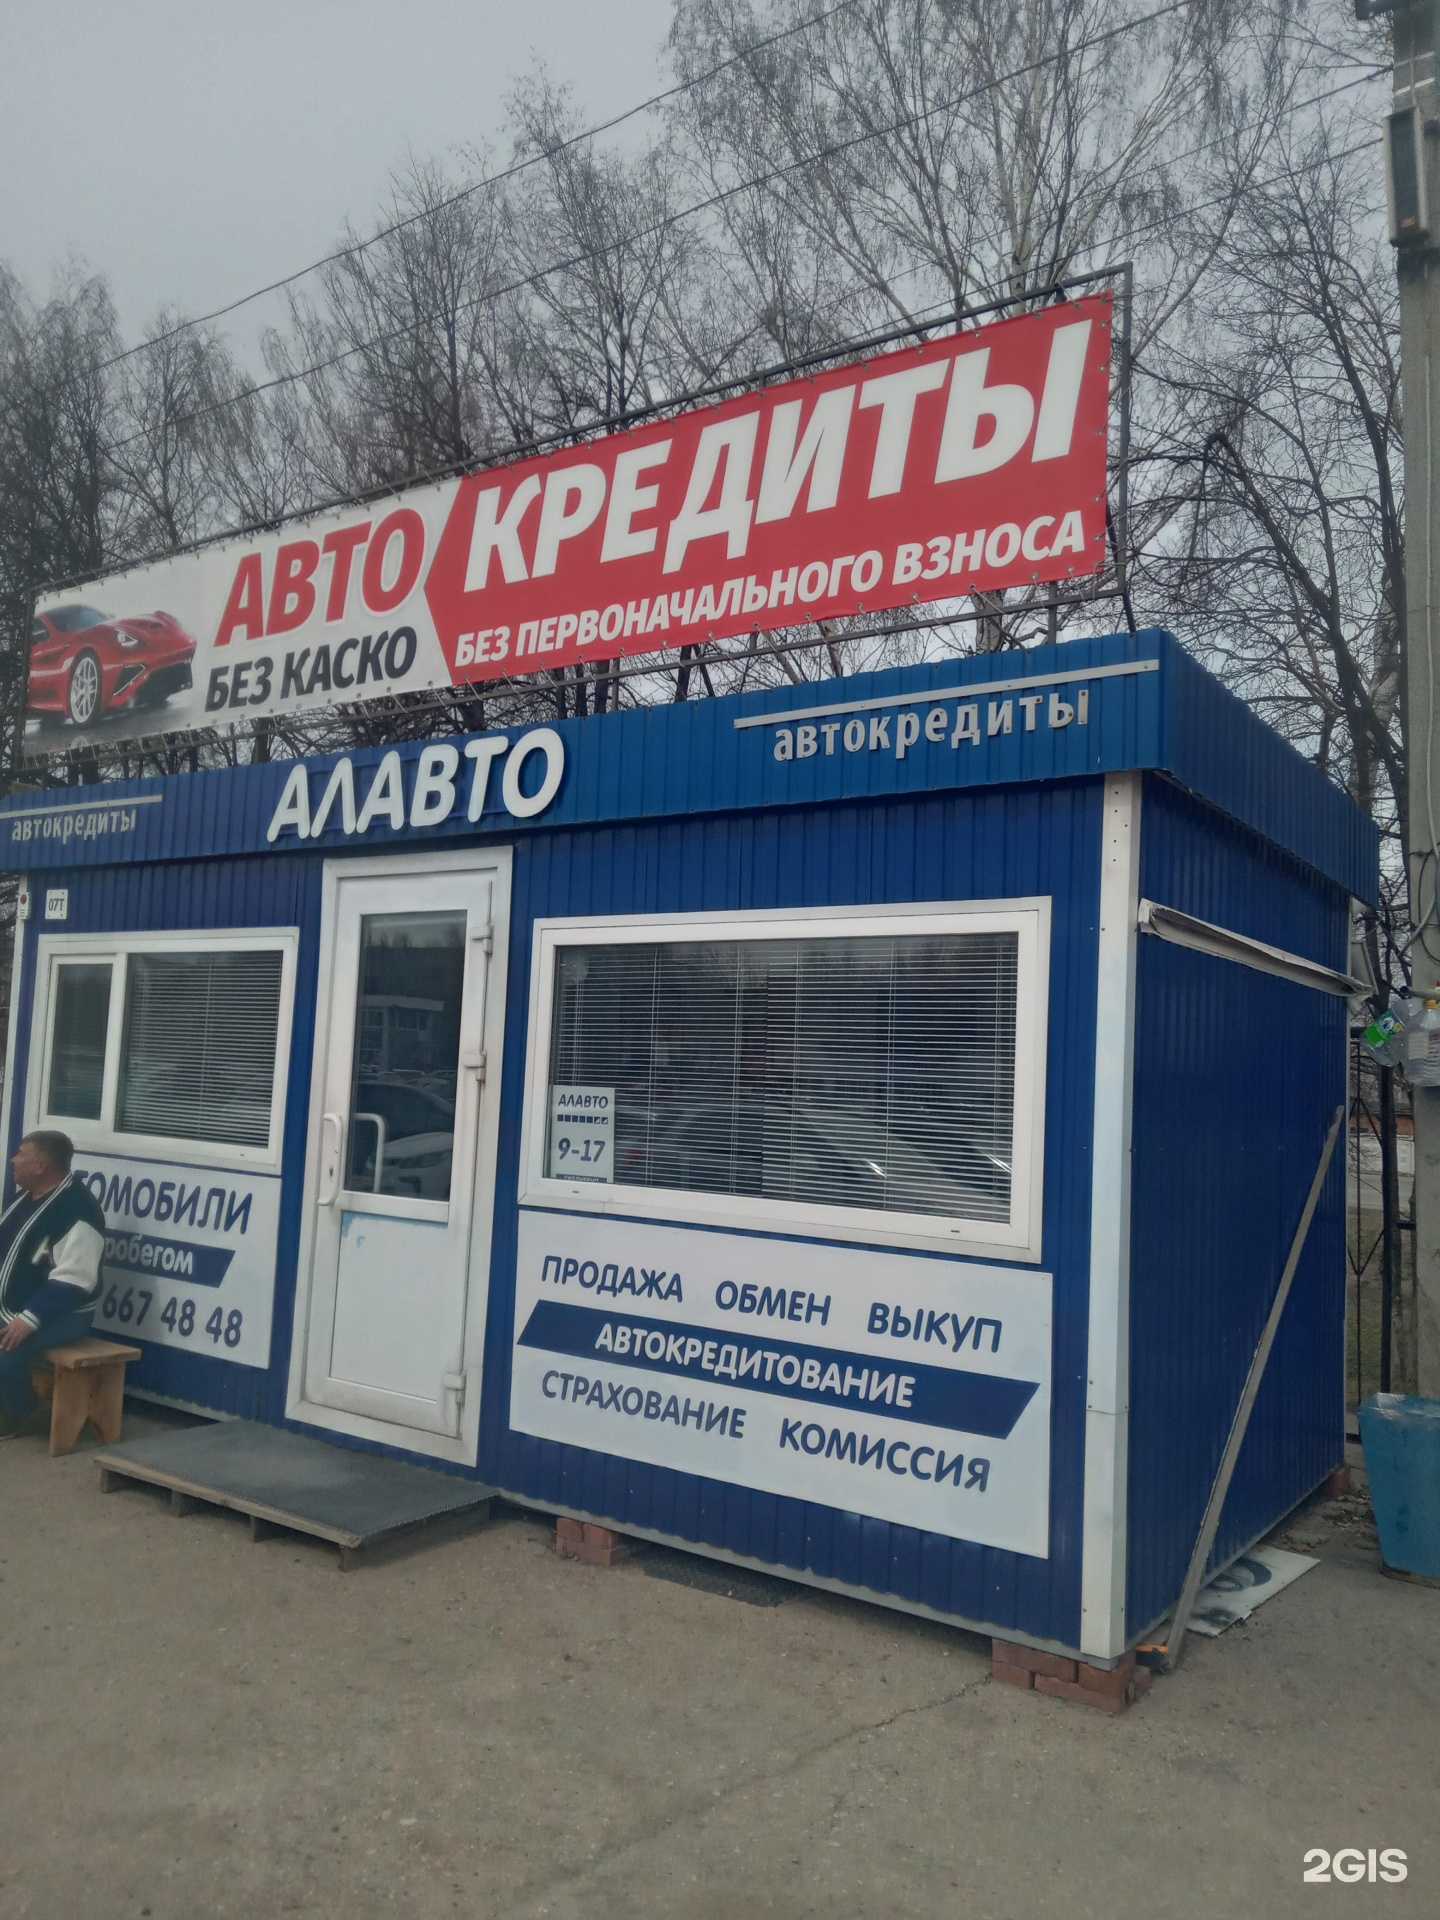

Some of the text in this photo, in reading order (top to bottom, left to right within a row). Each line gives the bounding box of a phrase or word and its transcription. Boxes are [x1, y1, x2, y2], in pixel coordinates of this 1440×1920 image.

[213, 319, 1092, 647] АВТО КРЕДИТЫ
[455, 510, 1086, 668] БЕЗ ПЕРВОНАЧАЛЬНОГО ВЗНОСА
[204, 626, 418, 713] БЕЗ КАСКО
[773, 689, 1088, 763] автокредиты
[267, 727, 565, 843] АЛАВТО
[11, 809, 137, 845] автокредиты
[558, 1093, 608, 1109] АЛАВТО
[558, 1137, 606, 1162] 9-17
[73, 1170, 253, 1235] ОМОБИЛИ
[104, 1233, 193, 1275] робегом
[102, 1284, 243, 1348] 667 48 48
[541, 1255, 1003, 1354] ПРОДАЖА ОБМЕН ВЫКУП
[594, 1322, 916, 1408] АВТОКРЕДИТОВАНИЕ
[541, 1369, 991, 1493] СТРАХОВАНИЕ КОМИССИЯ
